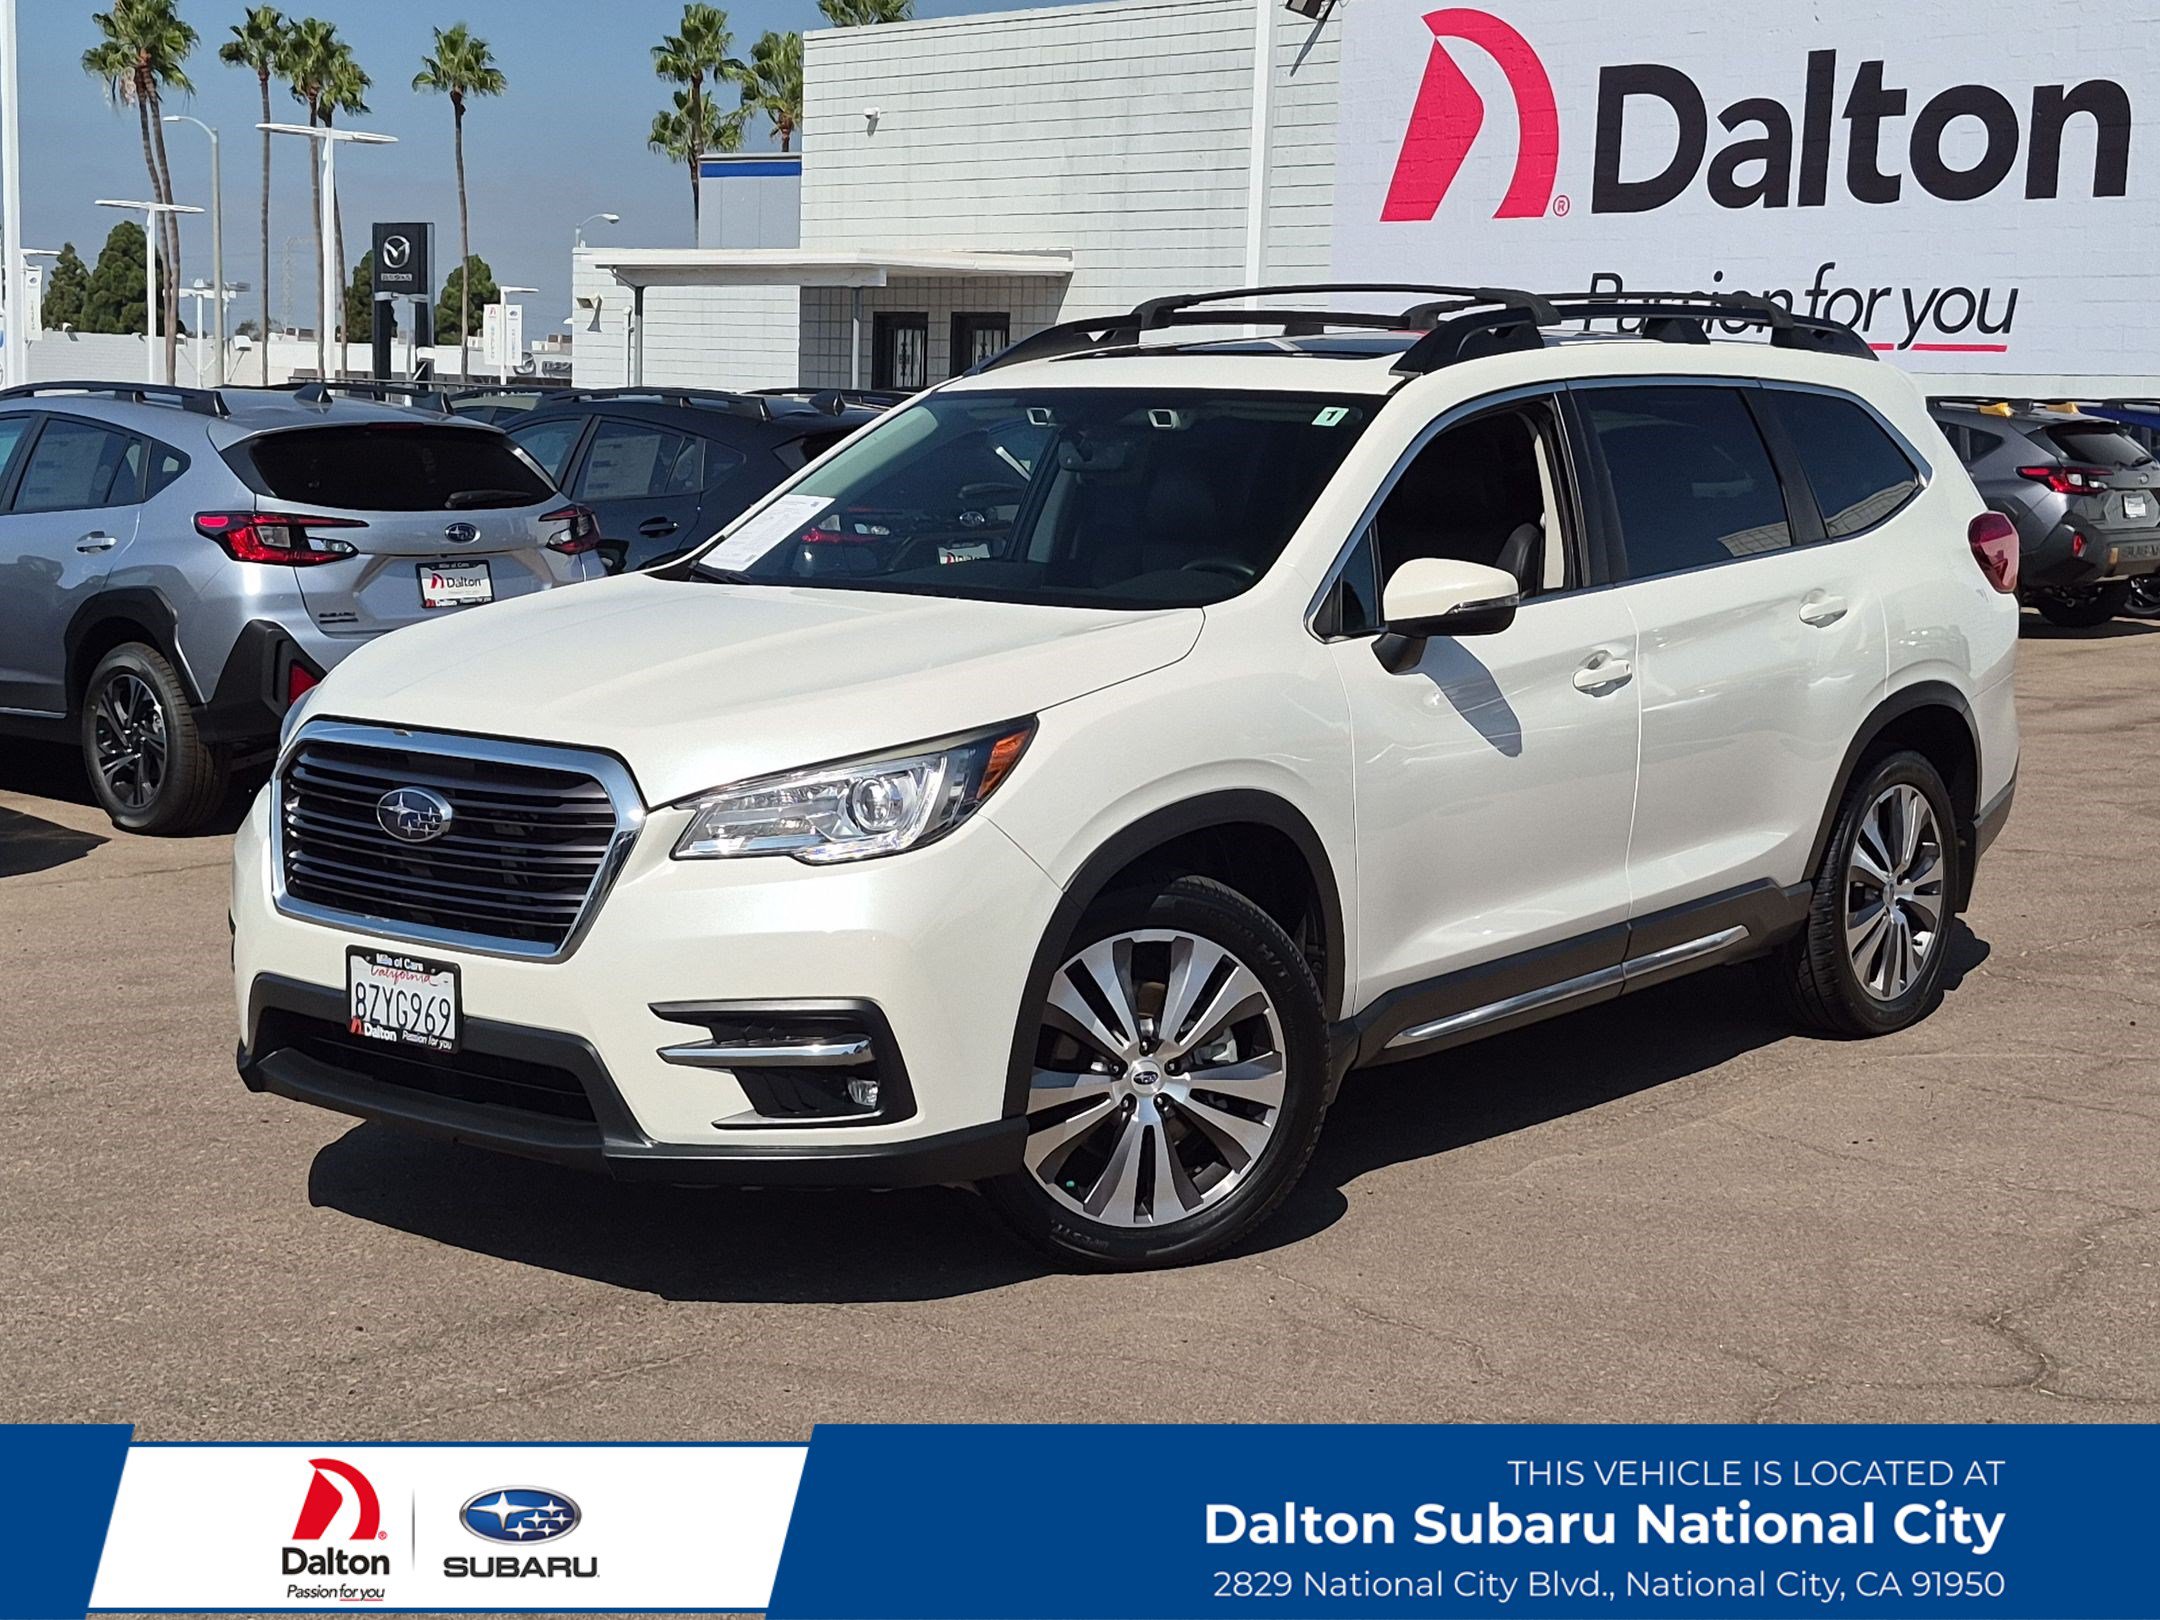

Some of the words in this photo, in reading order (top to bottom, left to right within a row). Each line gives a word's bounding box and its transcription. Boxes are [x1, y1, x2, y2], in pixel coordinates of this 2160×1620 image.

[1592, 49, 2131, 213] Dalton
[1804, 262, 1893, 334] for
[1897, 286, 2018, 351] you
[1326, 409, 1338, 422] 1
[446, 575, 481, 588] Dalton
[355, 982, 451, 1036] 8ZYG969
[364, 1023, 397, 1042] Dalton
[439, 1039, 452, 1050] you
